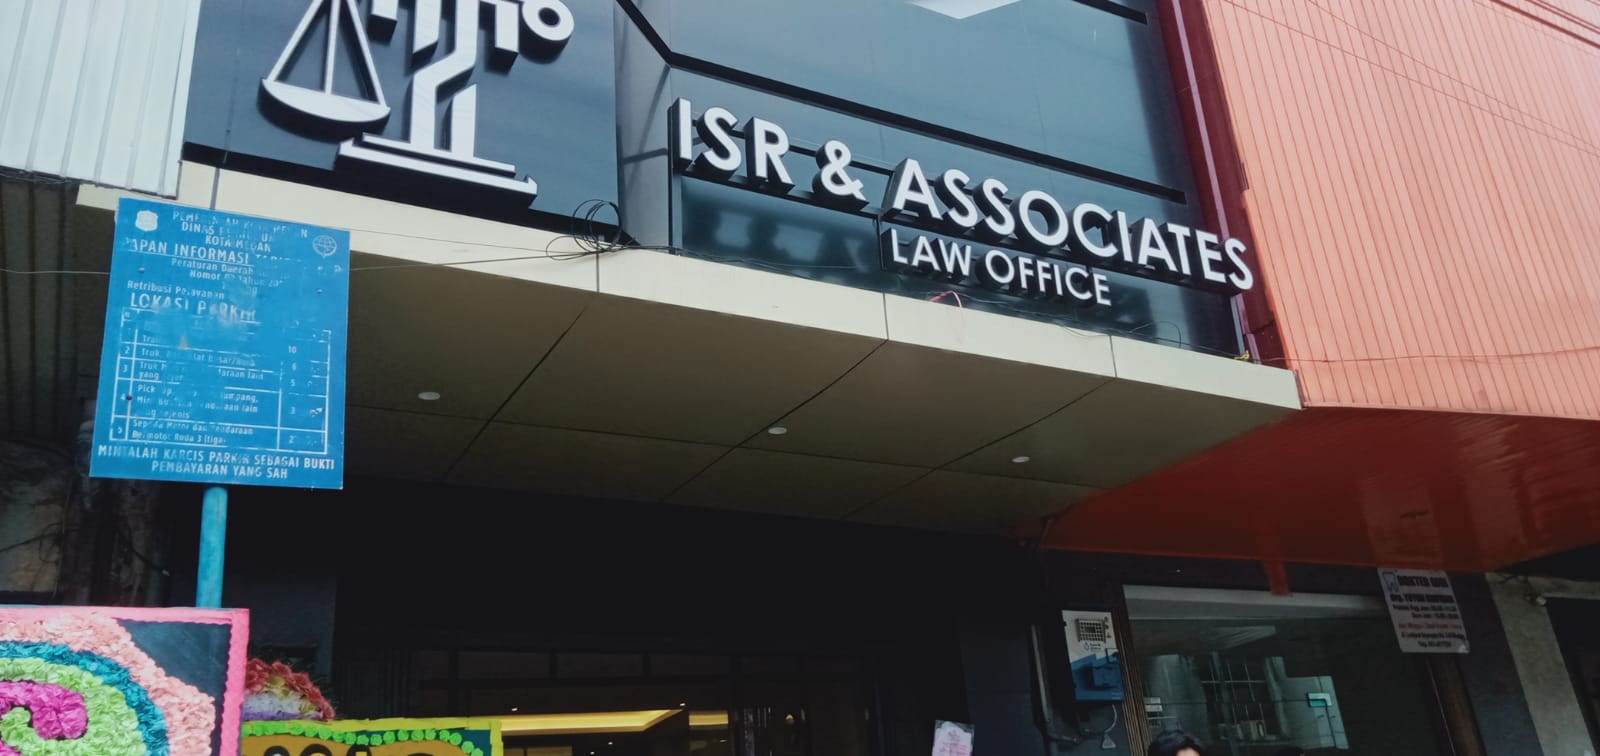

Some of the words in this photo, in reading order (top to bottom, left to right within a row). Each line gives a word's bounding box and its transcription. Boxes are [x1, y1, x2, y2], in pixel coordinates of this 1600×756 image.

[677, 97, 793, 186] ISR
[819, 139, 864, 200] &
[892, 156, 1255, 293] ASSOCIATES
[181, 221, 215, 236] DINAS
[125, 237, 168, 254] APAN
[173, 243, 250, 264] INFORMASI
[205, 235, 232, 247] KOTA
[171, 257, 218, 271] Peraturan
[890, 228, 972, 278] LAW
[985, 250, 1112, 308] OFFICE
[189, 269, 221, 281] Nomor
[127, 279, 172, 294] Retribusi
[130, 292, 190, 312] LOKASI
[137, 383, 157, 394] Pick
[131, 417, 164, 431] Sepda
[211, 424, 254, 436] endaraan
[97, 443, 159, 460] MINTALAH
[163, 447, 205, 463] KARCIS
[253, 453, 300, 469] SEBAGAI
[303, 456, 336, 471] BUKTI
[151, 460, 229, 476] PEMBAYARAN
[233, 463, 263, 477] YANG
[266, 466, 289, 480] SAH
